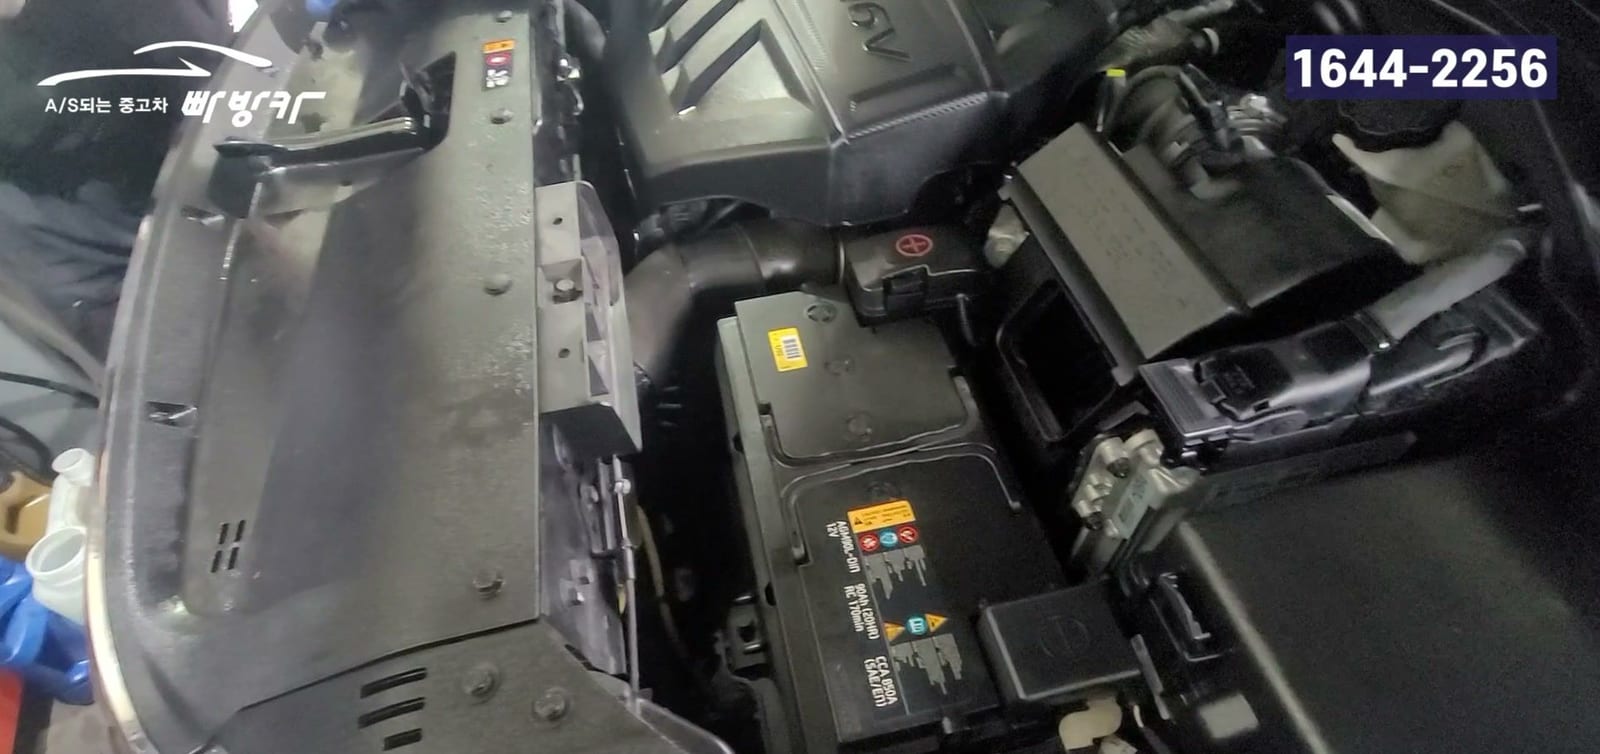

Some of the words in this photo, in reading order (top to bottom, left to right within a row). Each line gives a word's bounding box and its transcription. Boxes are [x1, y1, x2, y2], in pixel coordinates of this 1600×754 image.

[826, 522, 840, 538] 12V
[844, 585, 856, 599] RC
[847, 599, 864, 632] 170min
[854, 583, 870, 605] 90Ah
[863, 605, 880, 640] (20HR)
[875, 655, 890, 678] CCA
[882, 678, 899, 705] 850A
